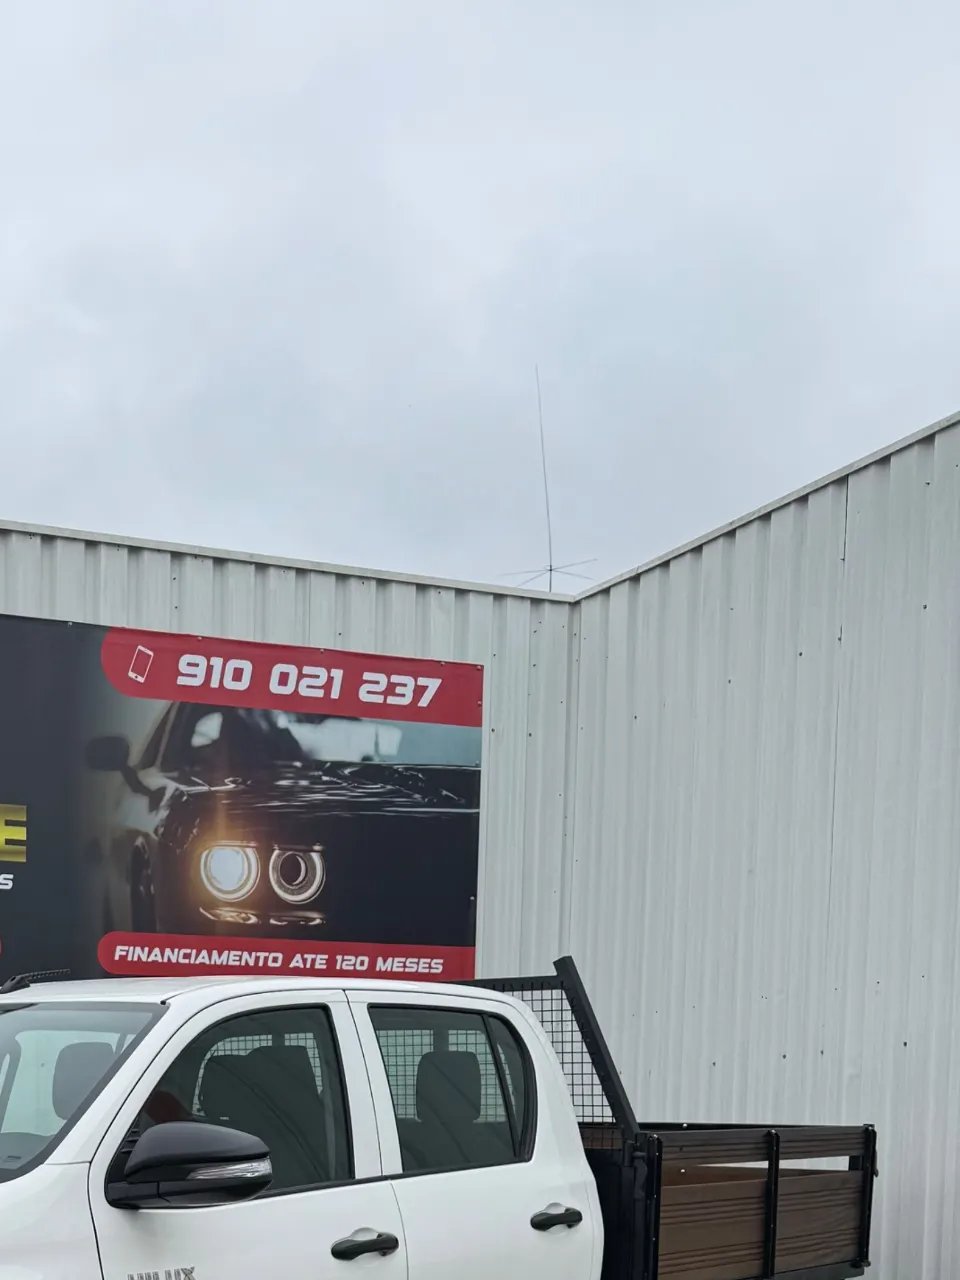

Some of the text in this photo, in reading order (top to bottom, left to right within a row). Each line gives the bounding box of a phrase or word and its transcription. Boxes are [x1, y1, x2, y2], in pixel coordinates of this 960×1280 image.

[176, 653, 442, 708] 910 021 237
[113, 944, 445, 975] FINANCIAMENTO ATE 120 MESES
